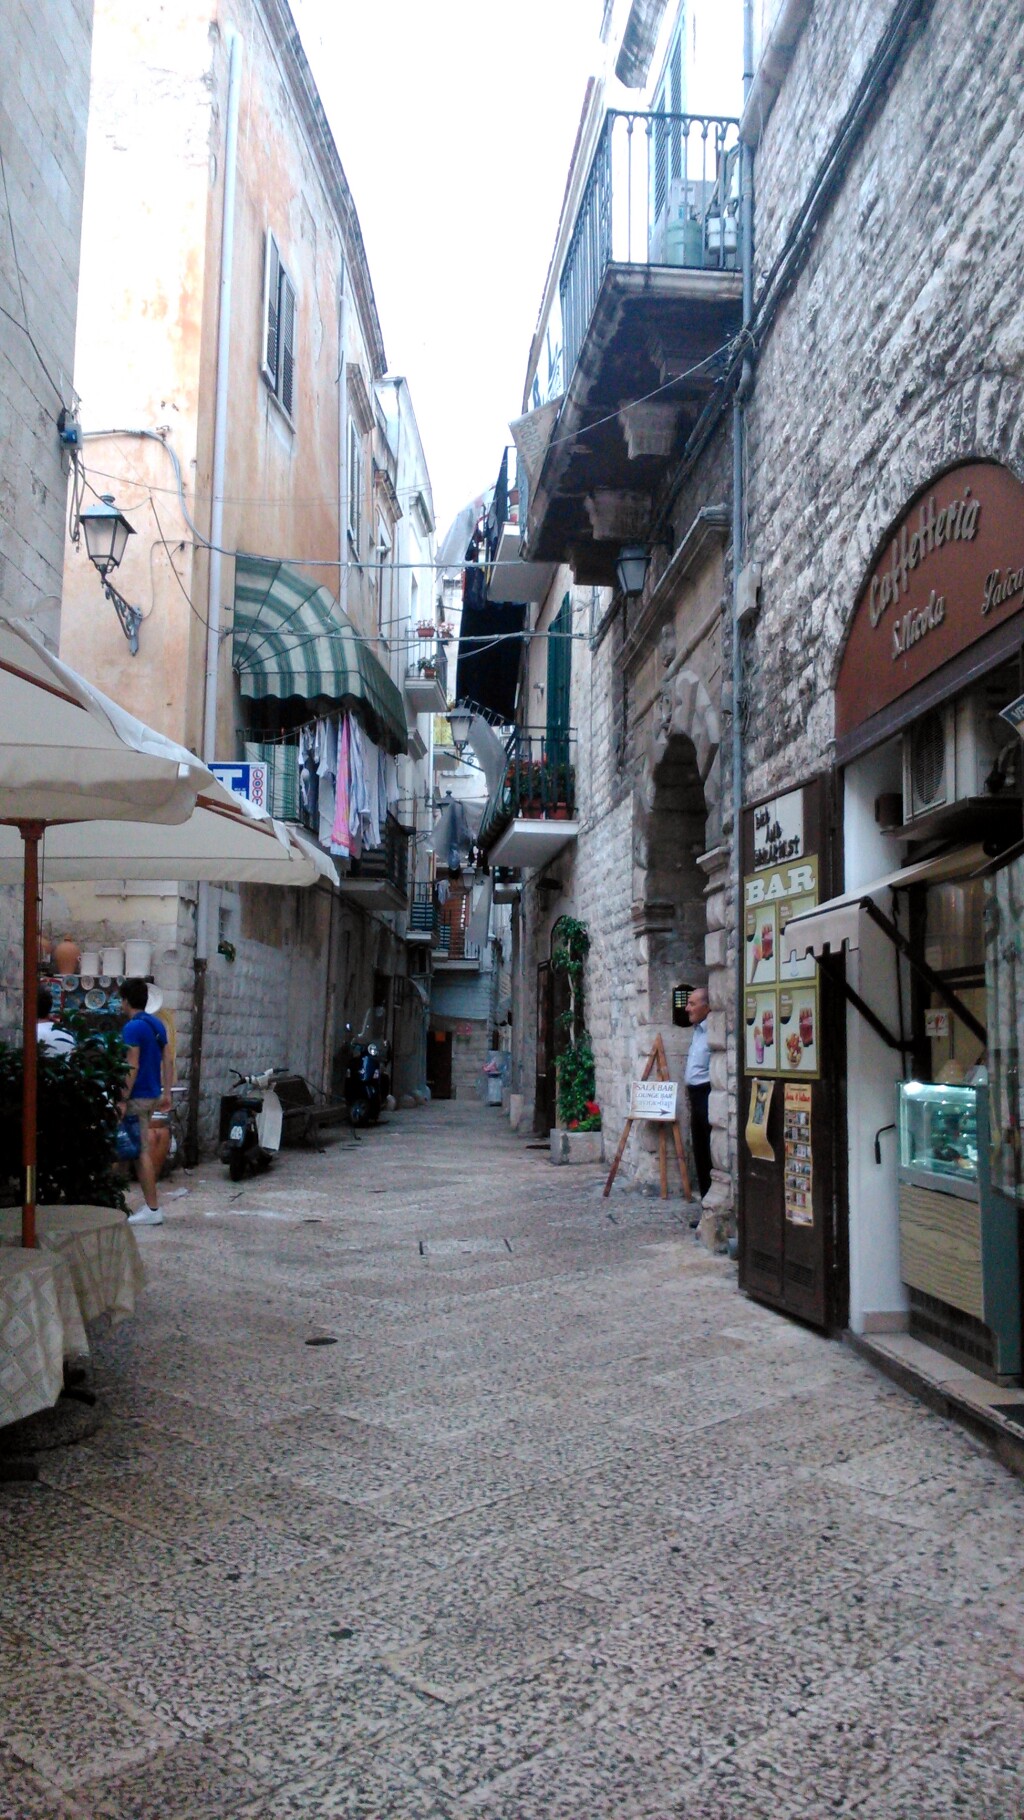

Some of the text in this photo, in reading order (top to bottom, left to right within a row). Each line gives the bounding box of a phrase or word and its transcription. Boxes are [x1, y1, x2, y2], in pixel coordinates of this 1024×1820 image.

[869, 486, 981, 628] Caffetteria
[745, 864, 816, 906] BAR
[657, 1084, 674, 1092] BAR
